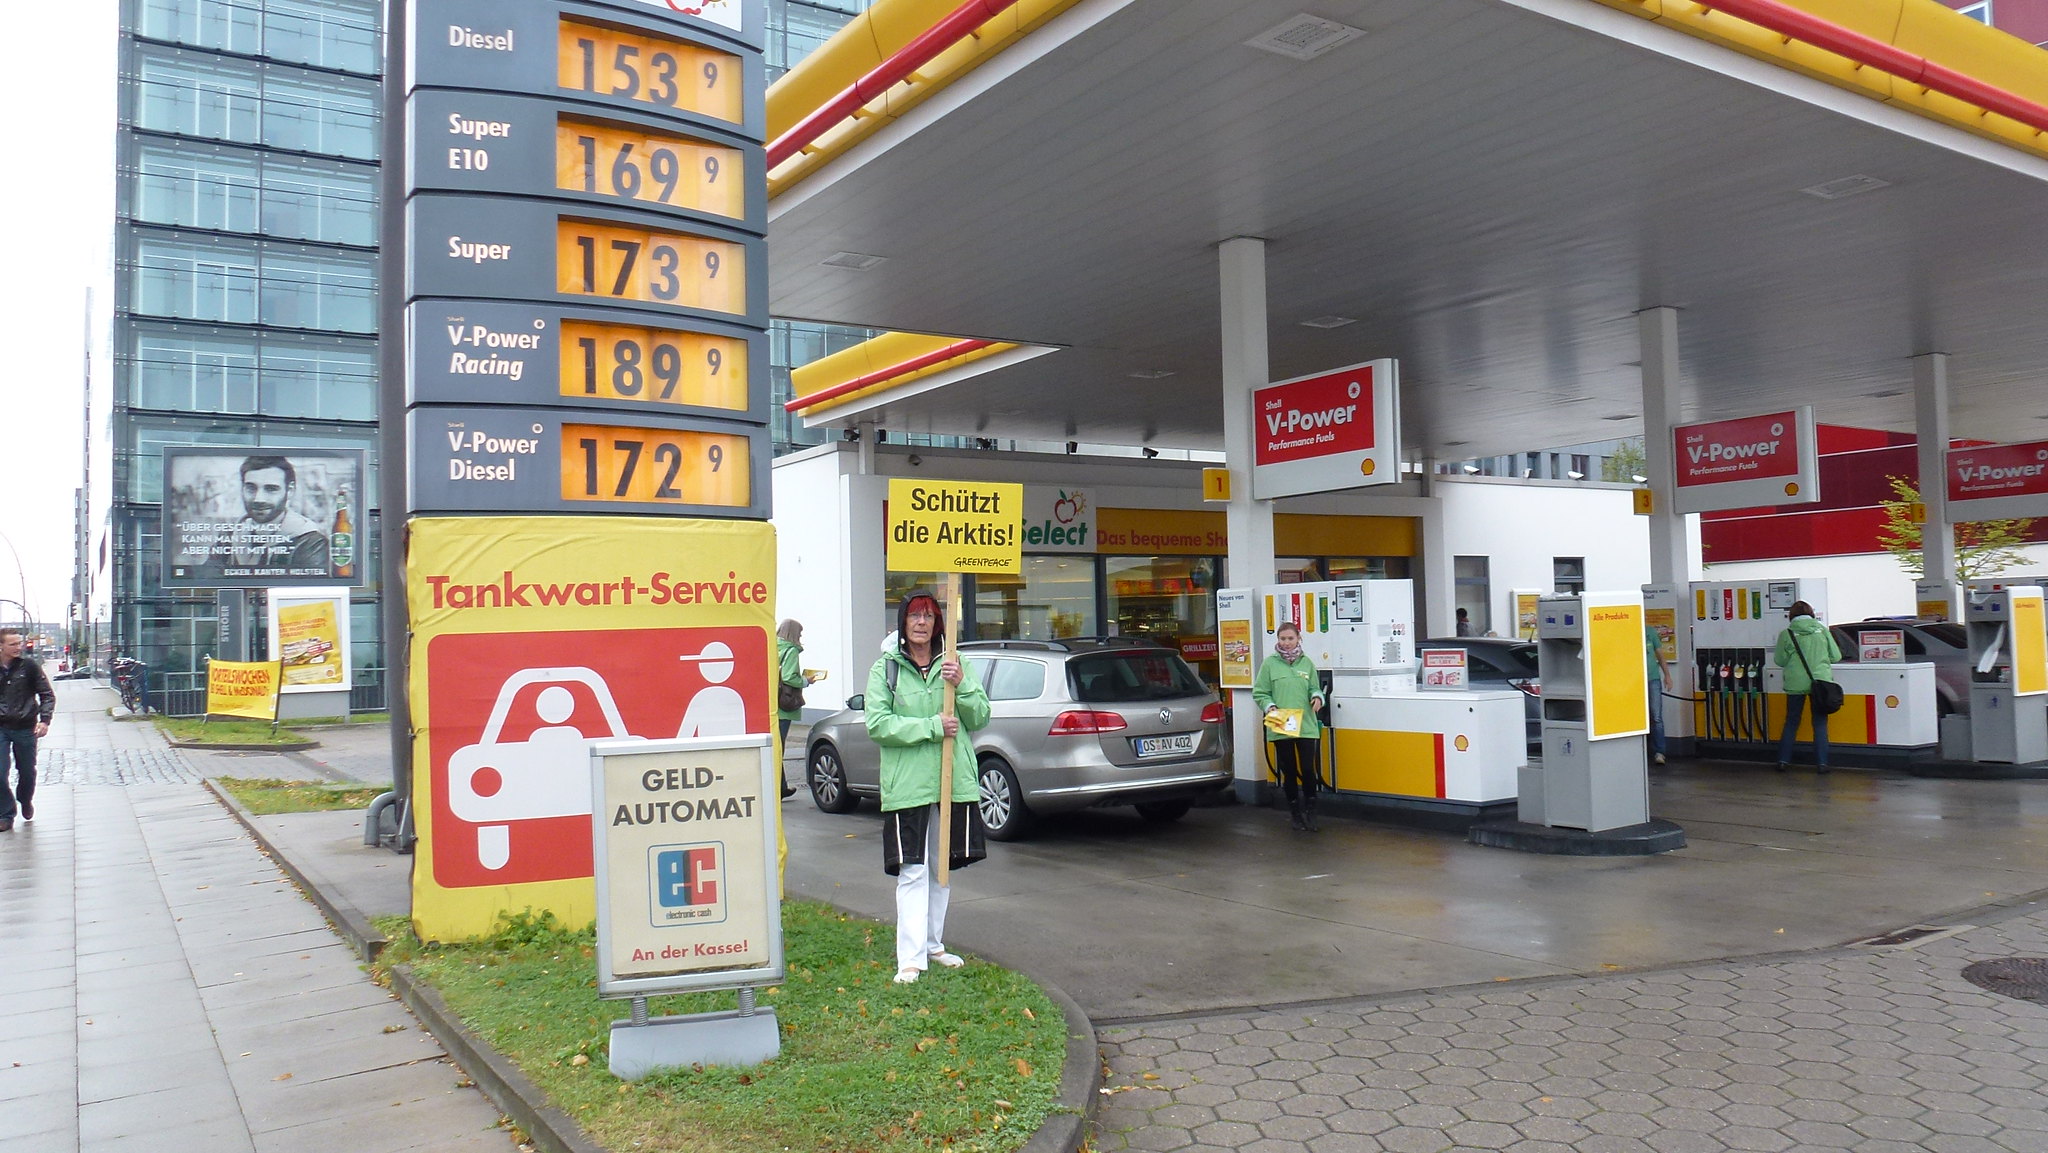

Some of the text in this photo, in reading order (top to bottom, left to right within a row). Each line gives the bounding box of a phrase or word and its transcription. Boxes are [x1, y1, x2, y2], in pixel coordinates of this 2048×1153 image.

[449, 25, 513, 51] Diesel
[578, 38, 718, 107] 153 9
[449, 113, 511, 141] Super
[449, 148, 489, 172] E10
[578, 136, 719, 203] 169 9
[449, 236, 511, 264] Super
[577, 236, 720, 300] 173 9
[447, 325, 541, 349] V-Power
[450, 352, 524, 381] Racing
[579, 337, 722, 399] 189 9
[1265, 399, 1282, 410] Shell
[1265, 404, 1357, 436] V-Power
[447, 431, 539, 454] V-Power
[1268, 431, 1335, 452] Performance Fuels
[1686, 435, 1704, 444] Shell
[1686, 440, 1780, 464] V-Power
[450, 458, 515, 481] Diesel
[580, 437, 723, 499] 172 9
[1689, 460, 1758, 476] Performance Fuels
[1958, 464, 2045, 482] V-Power
[1216, 476, 1223, 493] 1
[911, 487, 1000, 514] Schützt
[1642, 495, 1649, 508] 3
[181, 534, 212, 543] KANN
[215, 534, 239, 543] MAN
[213, 523, 282, 532] GESCHMACK
[894, 520, 1014, 547] die Arktis!
[181, 546, 210, 555] ABER
[211, 546, 245, 555] NICHT
[247, 546, 266, 555] MIT
[1096, 529, 1126, 547] Das
[1131, 529, 1201, 550] bequeme
[954, 557, 1012, 567] GREENPEACE
[426, 571, 768, 609] Tankwart-Service
[1593, 613, 1604, 621] Alle
[1143, 736, 1192, 752] OS AV 402
[642, 767, 725, 792] GELD-
[612, 795, 756, 827] AUTOMAT
[665, 907, 712, 920] electronic cash
[631, 940, 749, 962] An der Kasse!
